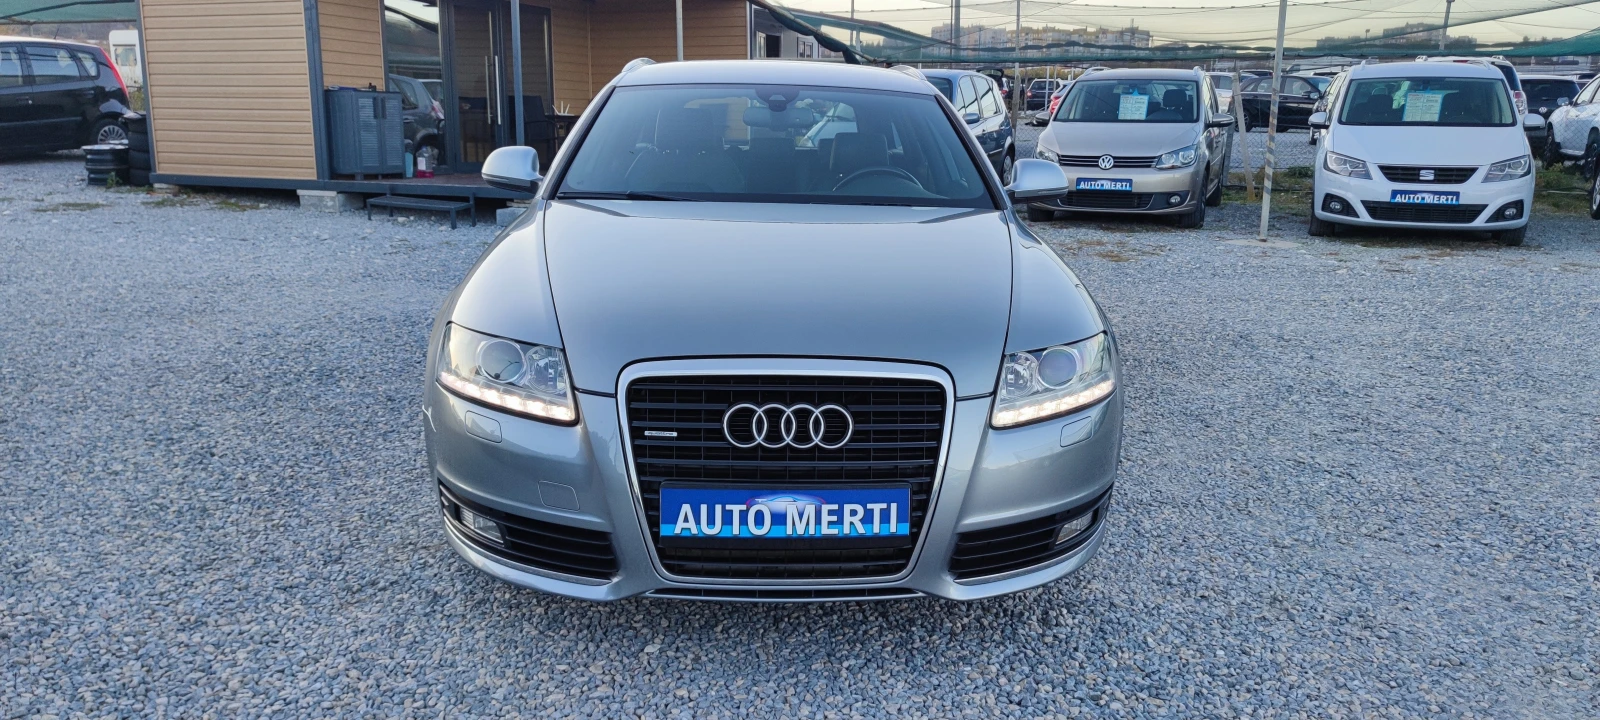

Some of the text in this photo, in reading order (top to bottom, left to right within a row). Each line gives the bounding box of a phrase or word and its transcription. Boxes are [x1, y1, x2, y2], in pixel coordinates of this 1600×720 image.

[1079, 181, 1130, 190] AUTO MERTI
[1394, 194, 1457, 204] AUTO MERTI
[673, 502, 898, 536] AUTO MERTI
